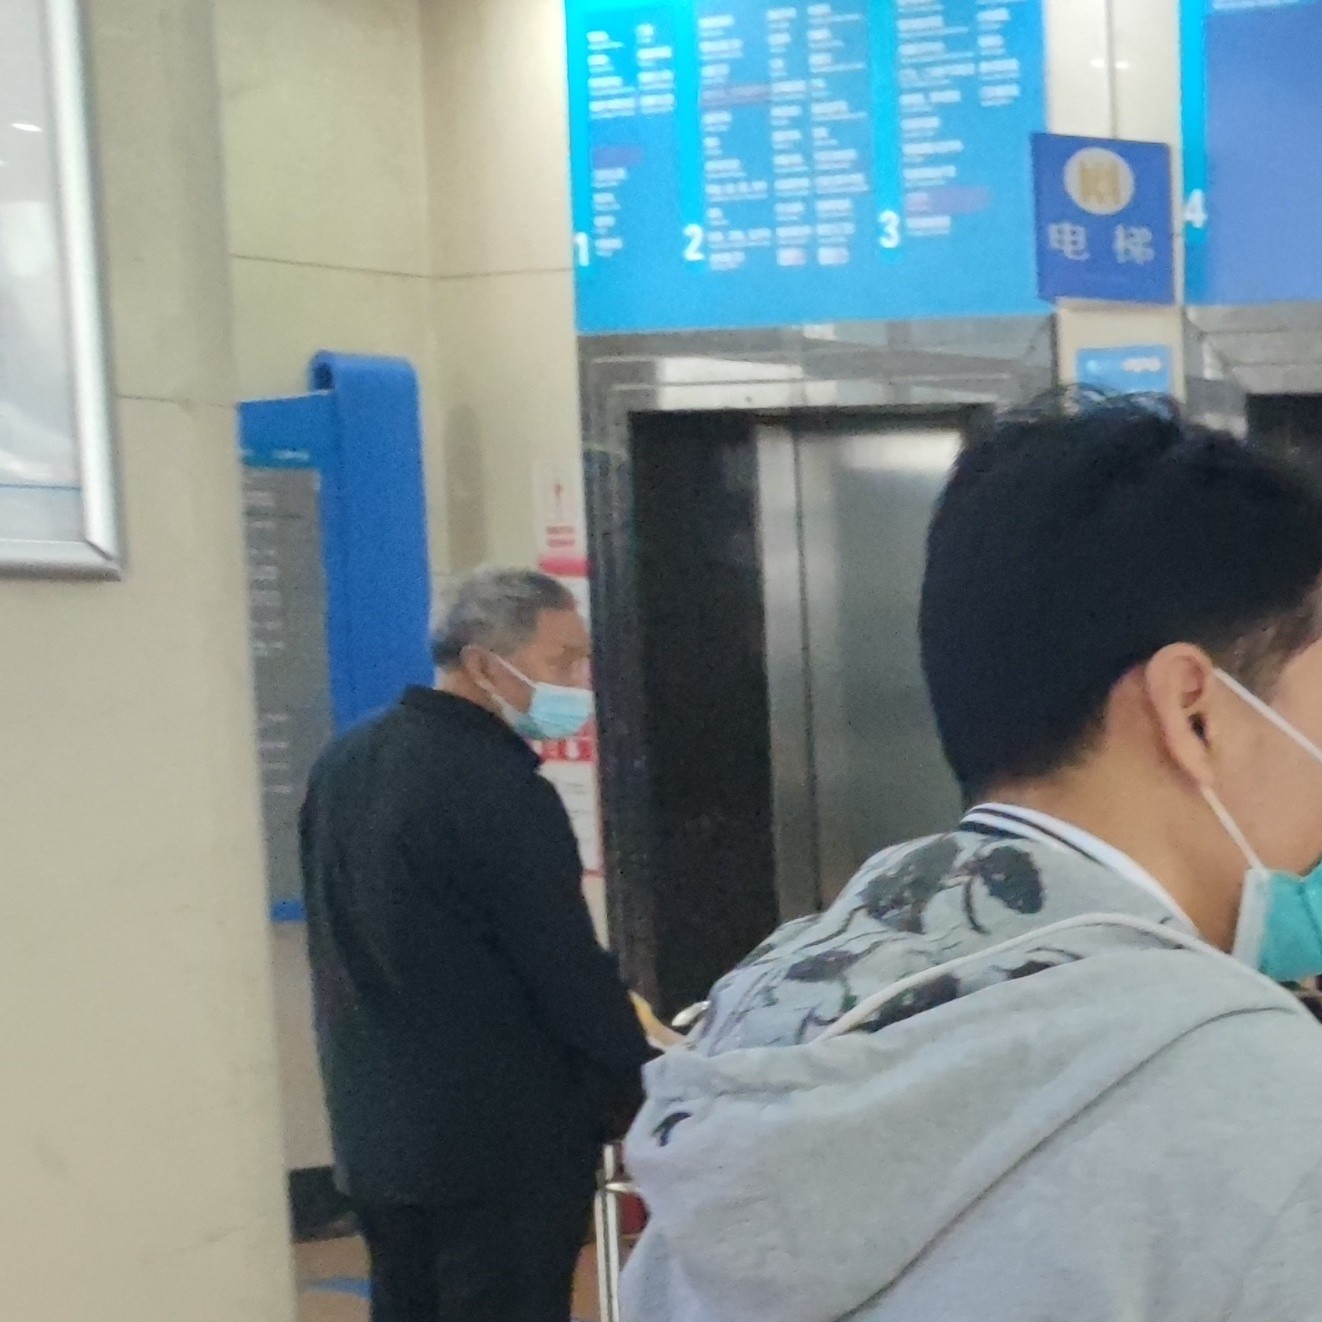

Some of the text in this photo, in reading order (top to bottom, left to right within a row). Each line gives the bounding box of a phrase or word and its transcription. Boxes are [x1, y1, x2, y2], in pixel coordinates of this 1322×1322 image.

[1182, 190, 1206, 228] 4
[573, 231, 590, 267] 1
[683, 223, 705, 262] 2
[878, 210, 901, 249] 3
[1048, 222, 1155, 266] 电梯
